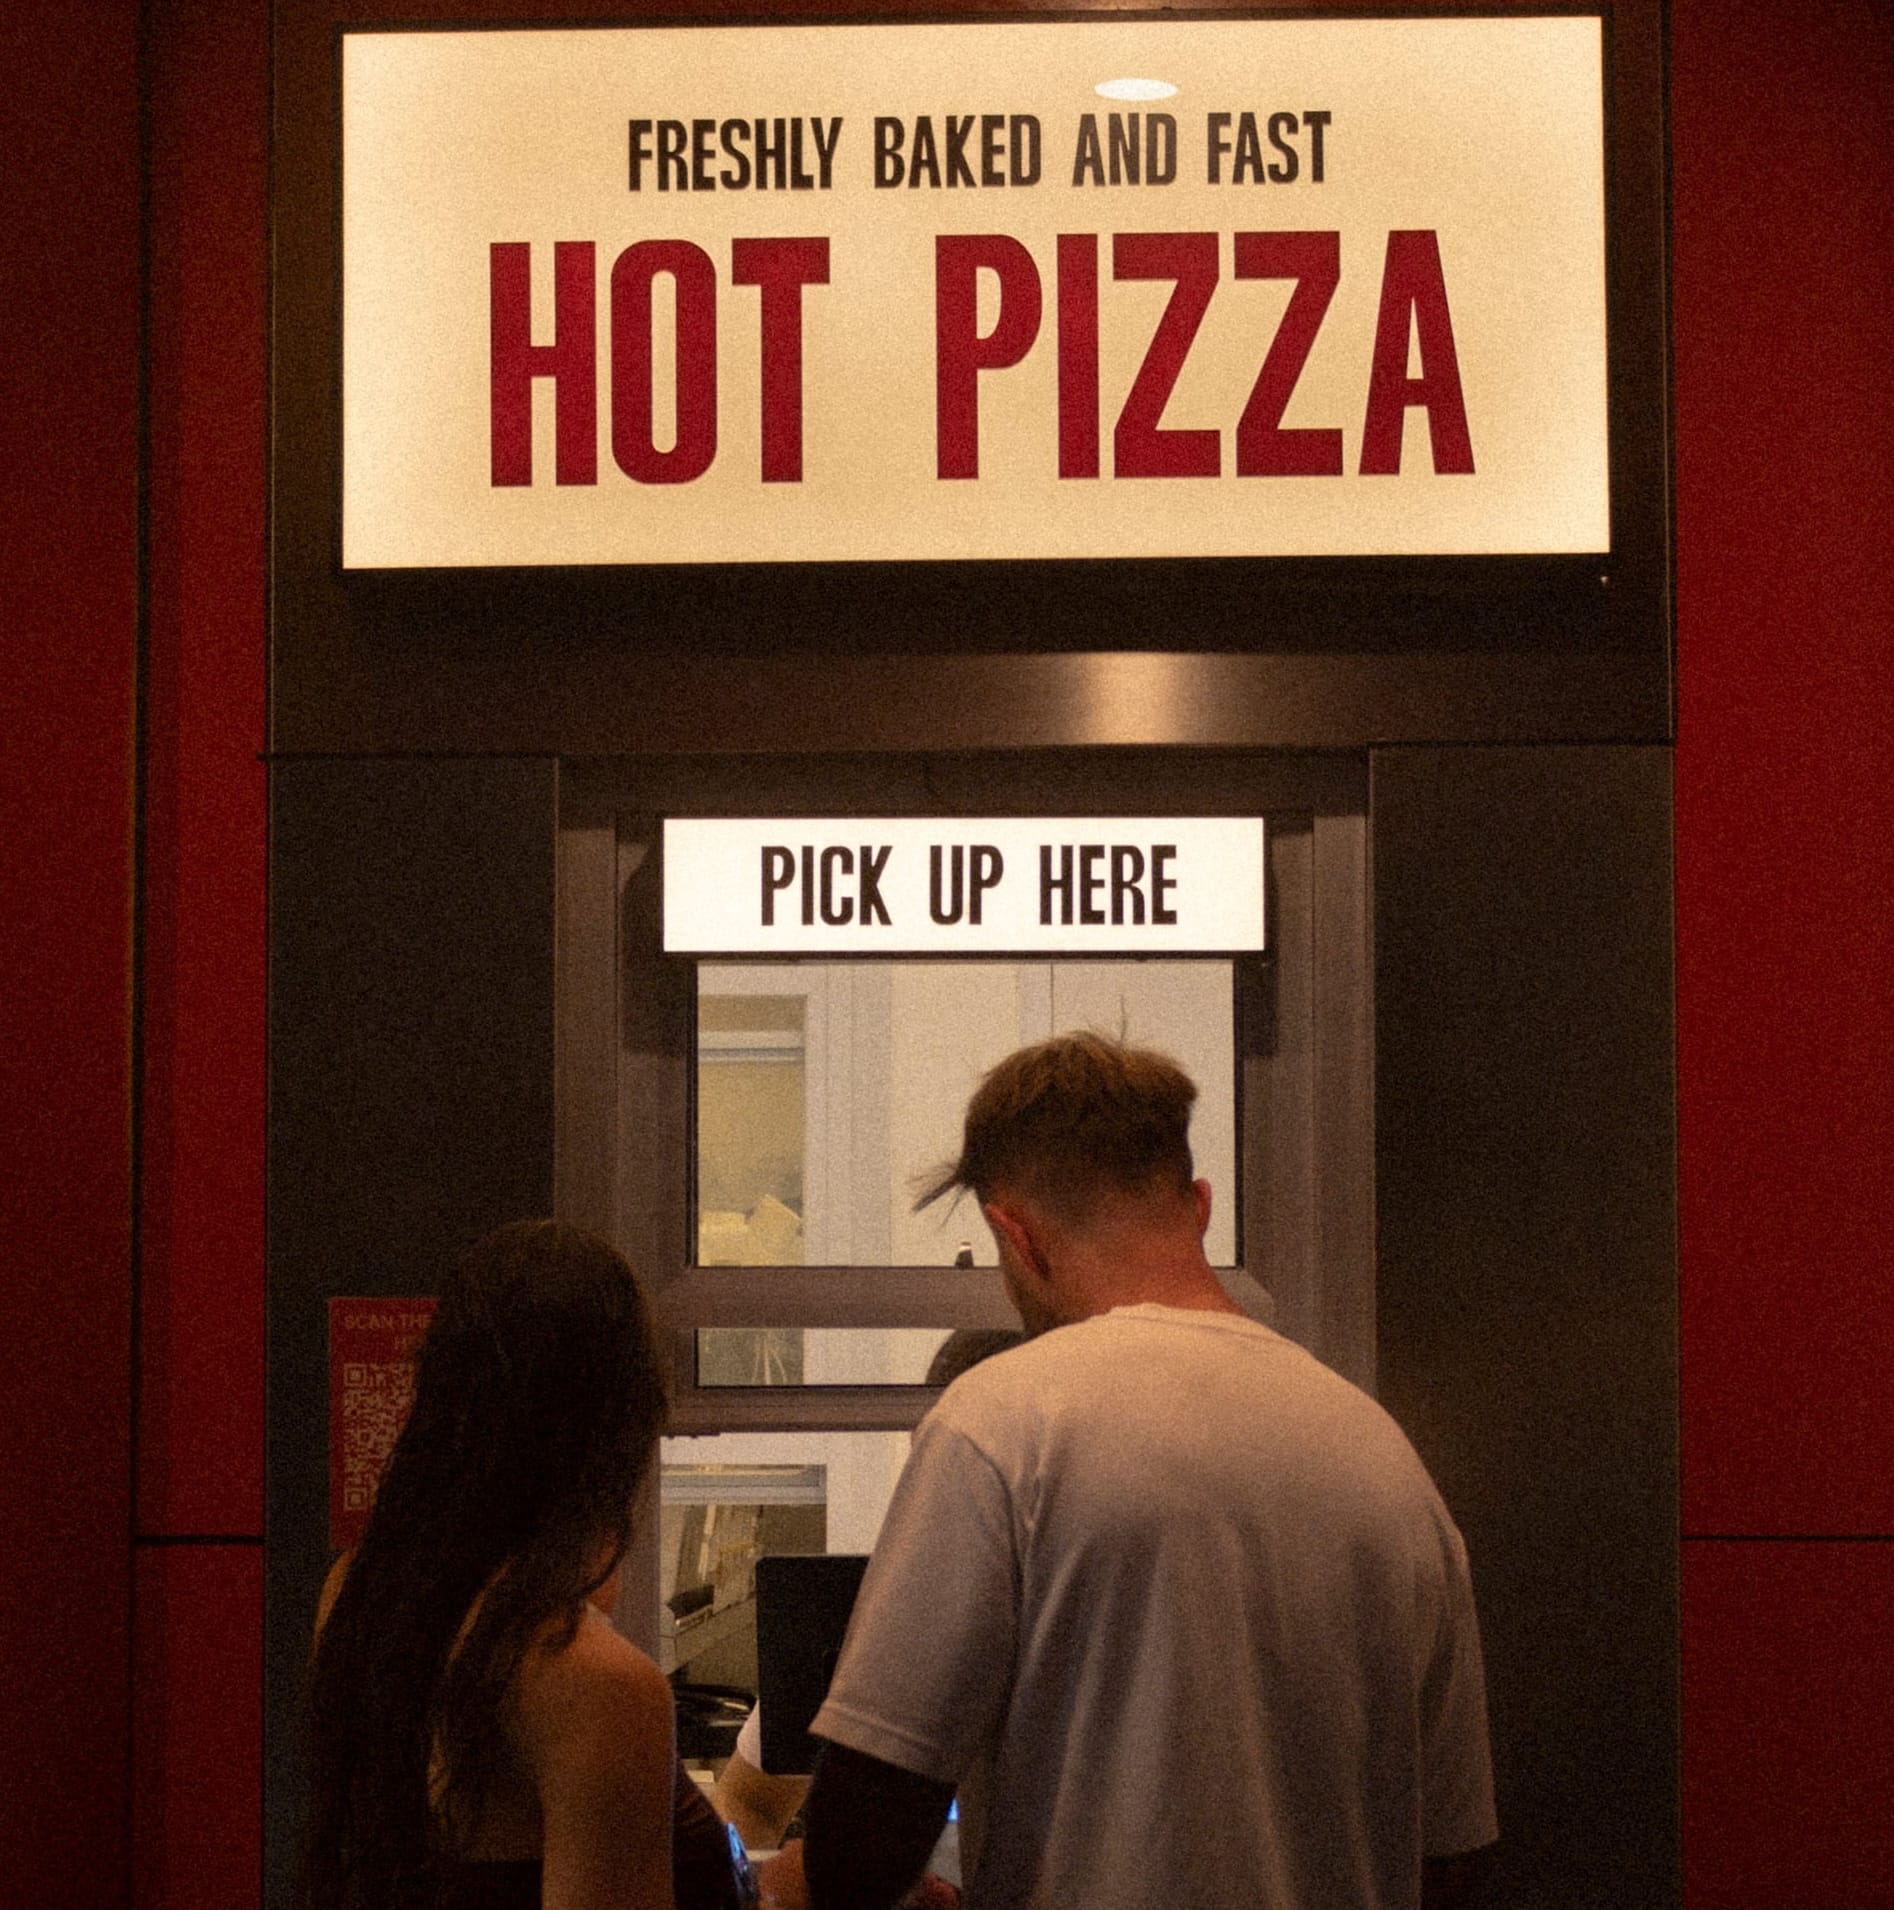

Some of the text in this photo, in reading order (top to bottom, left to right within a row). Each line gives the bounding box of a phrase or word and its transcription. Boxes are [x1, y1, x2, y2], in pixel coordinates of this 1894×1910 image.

[629, 111, 1332, 191] FRESHLY BAKED AND FAST
[490, 230, 1475, 487] HOT PIZZA
[762, 845, 1177, 925] PICK UP HERE
[344, 1314, 394, 1330] SCAN
